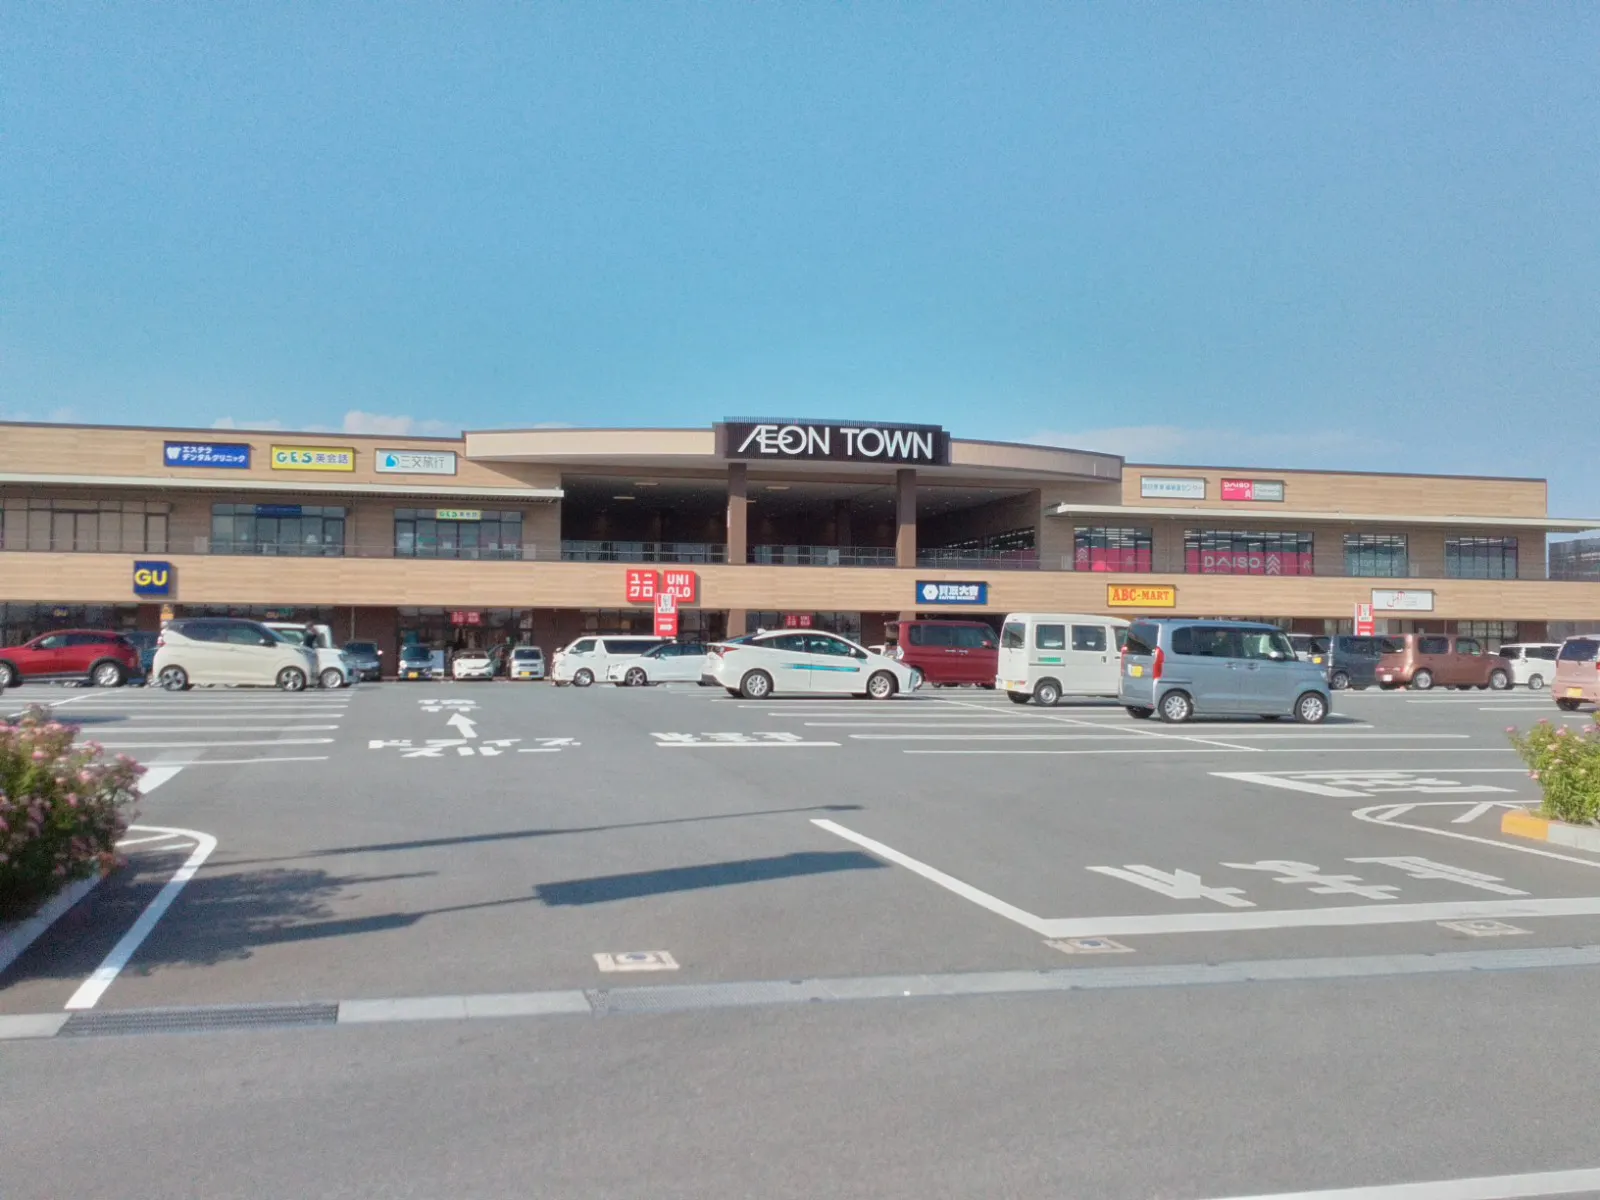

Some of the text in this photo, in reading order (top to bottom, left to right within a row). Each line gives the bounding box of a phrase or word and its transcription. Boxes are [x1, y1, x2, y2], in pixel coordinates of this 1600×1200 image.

[840, 428, 933, 460] TOWN
[182, 454, 246, 463] デンタルクリニック
[276, 451, 349, 465] GES 英会話
[400, 456, 445, 469] 三交旅行
[1223, 481, 1250, 489] DAISO
[1204, 555, 1261, 569] DAISO
[135, 569, 168, 587] GU
[629, 573, 654, 585] ユニ
[667, 574, 690, 585] UNI
[629, 586, 654, 598] クロ
[1112, 588, 1170, 601] ABC-MART
[1085, 856, 1532, 907] 止まれ
